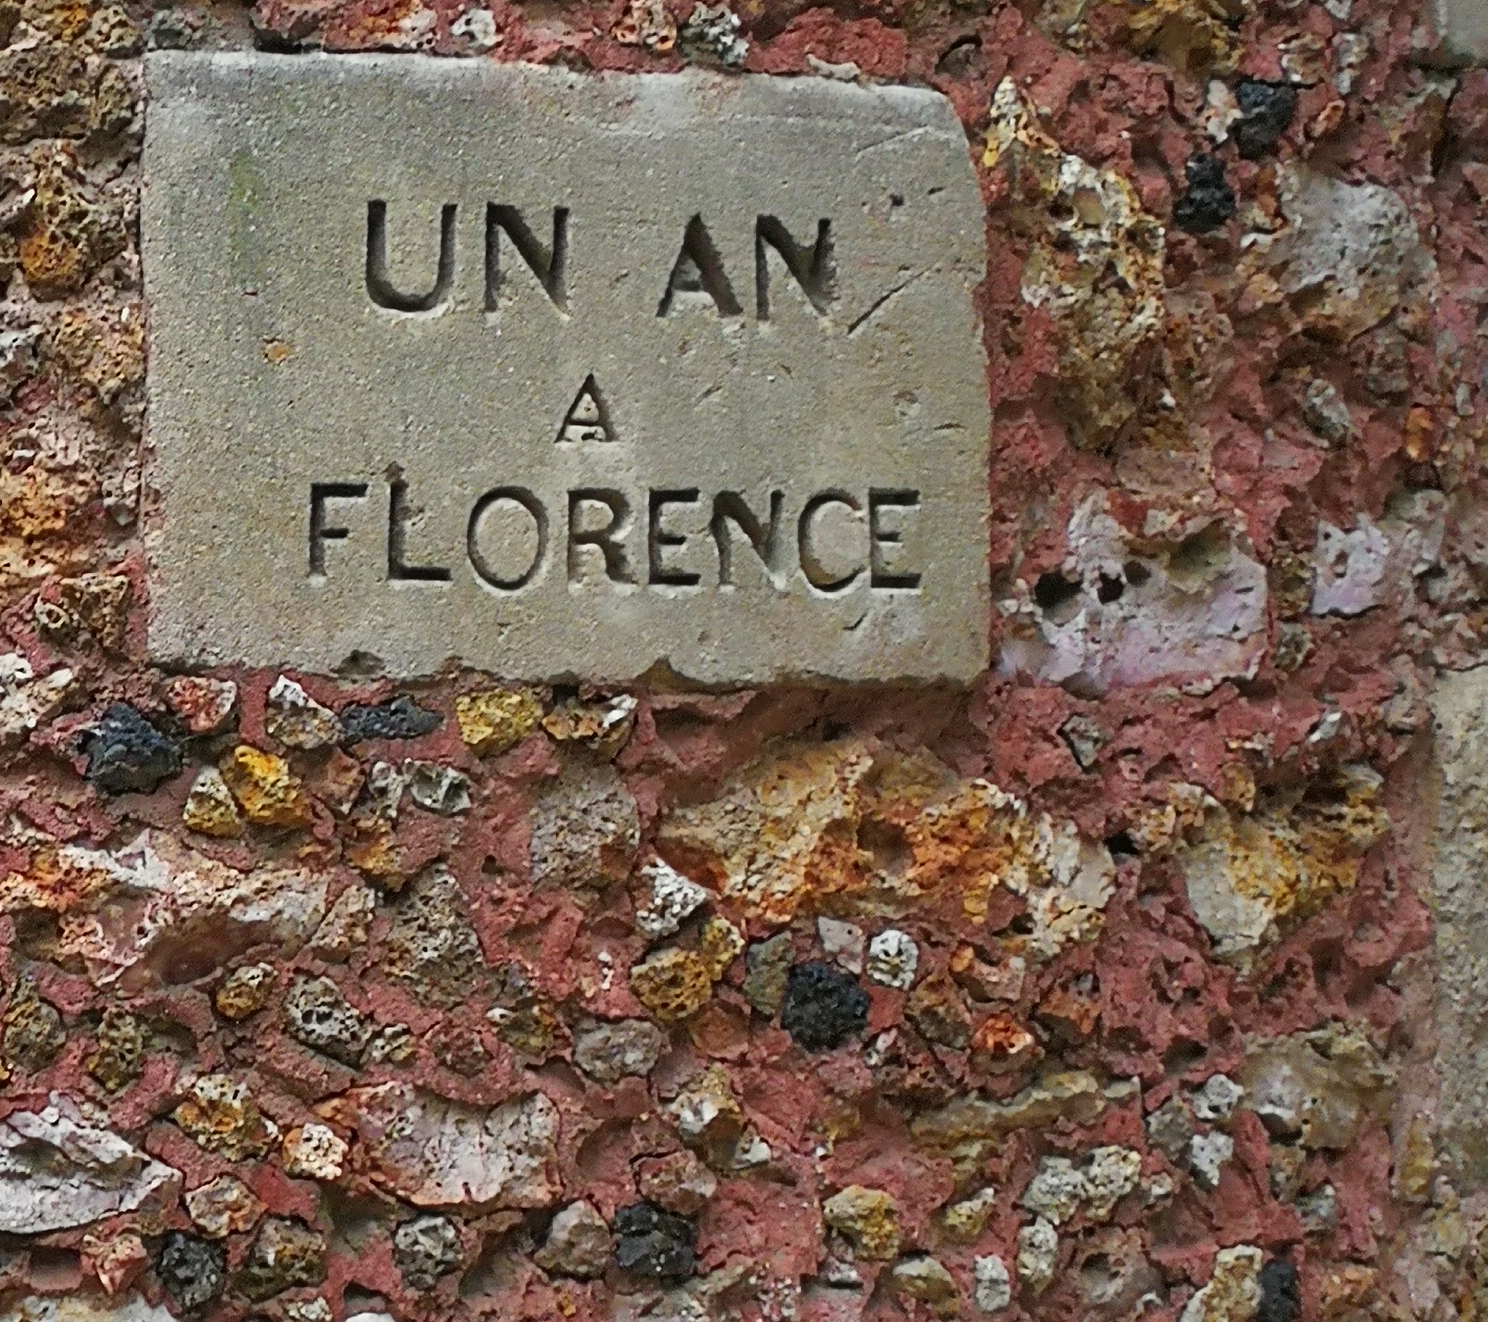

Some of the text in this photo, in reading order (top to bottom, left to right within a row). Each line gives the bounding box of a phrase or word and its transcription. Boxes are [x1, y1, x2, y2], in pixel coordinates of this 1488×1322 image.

[366, 199, 838, 322] UN AN
[555, 374, 618, 444] A
[308, 478, 921, 593] FLORENCE
